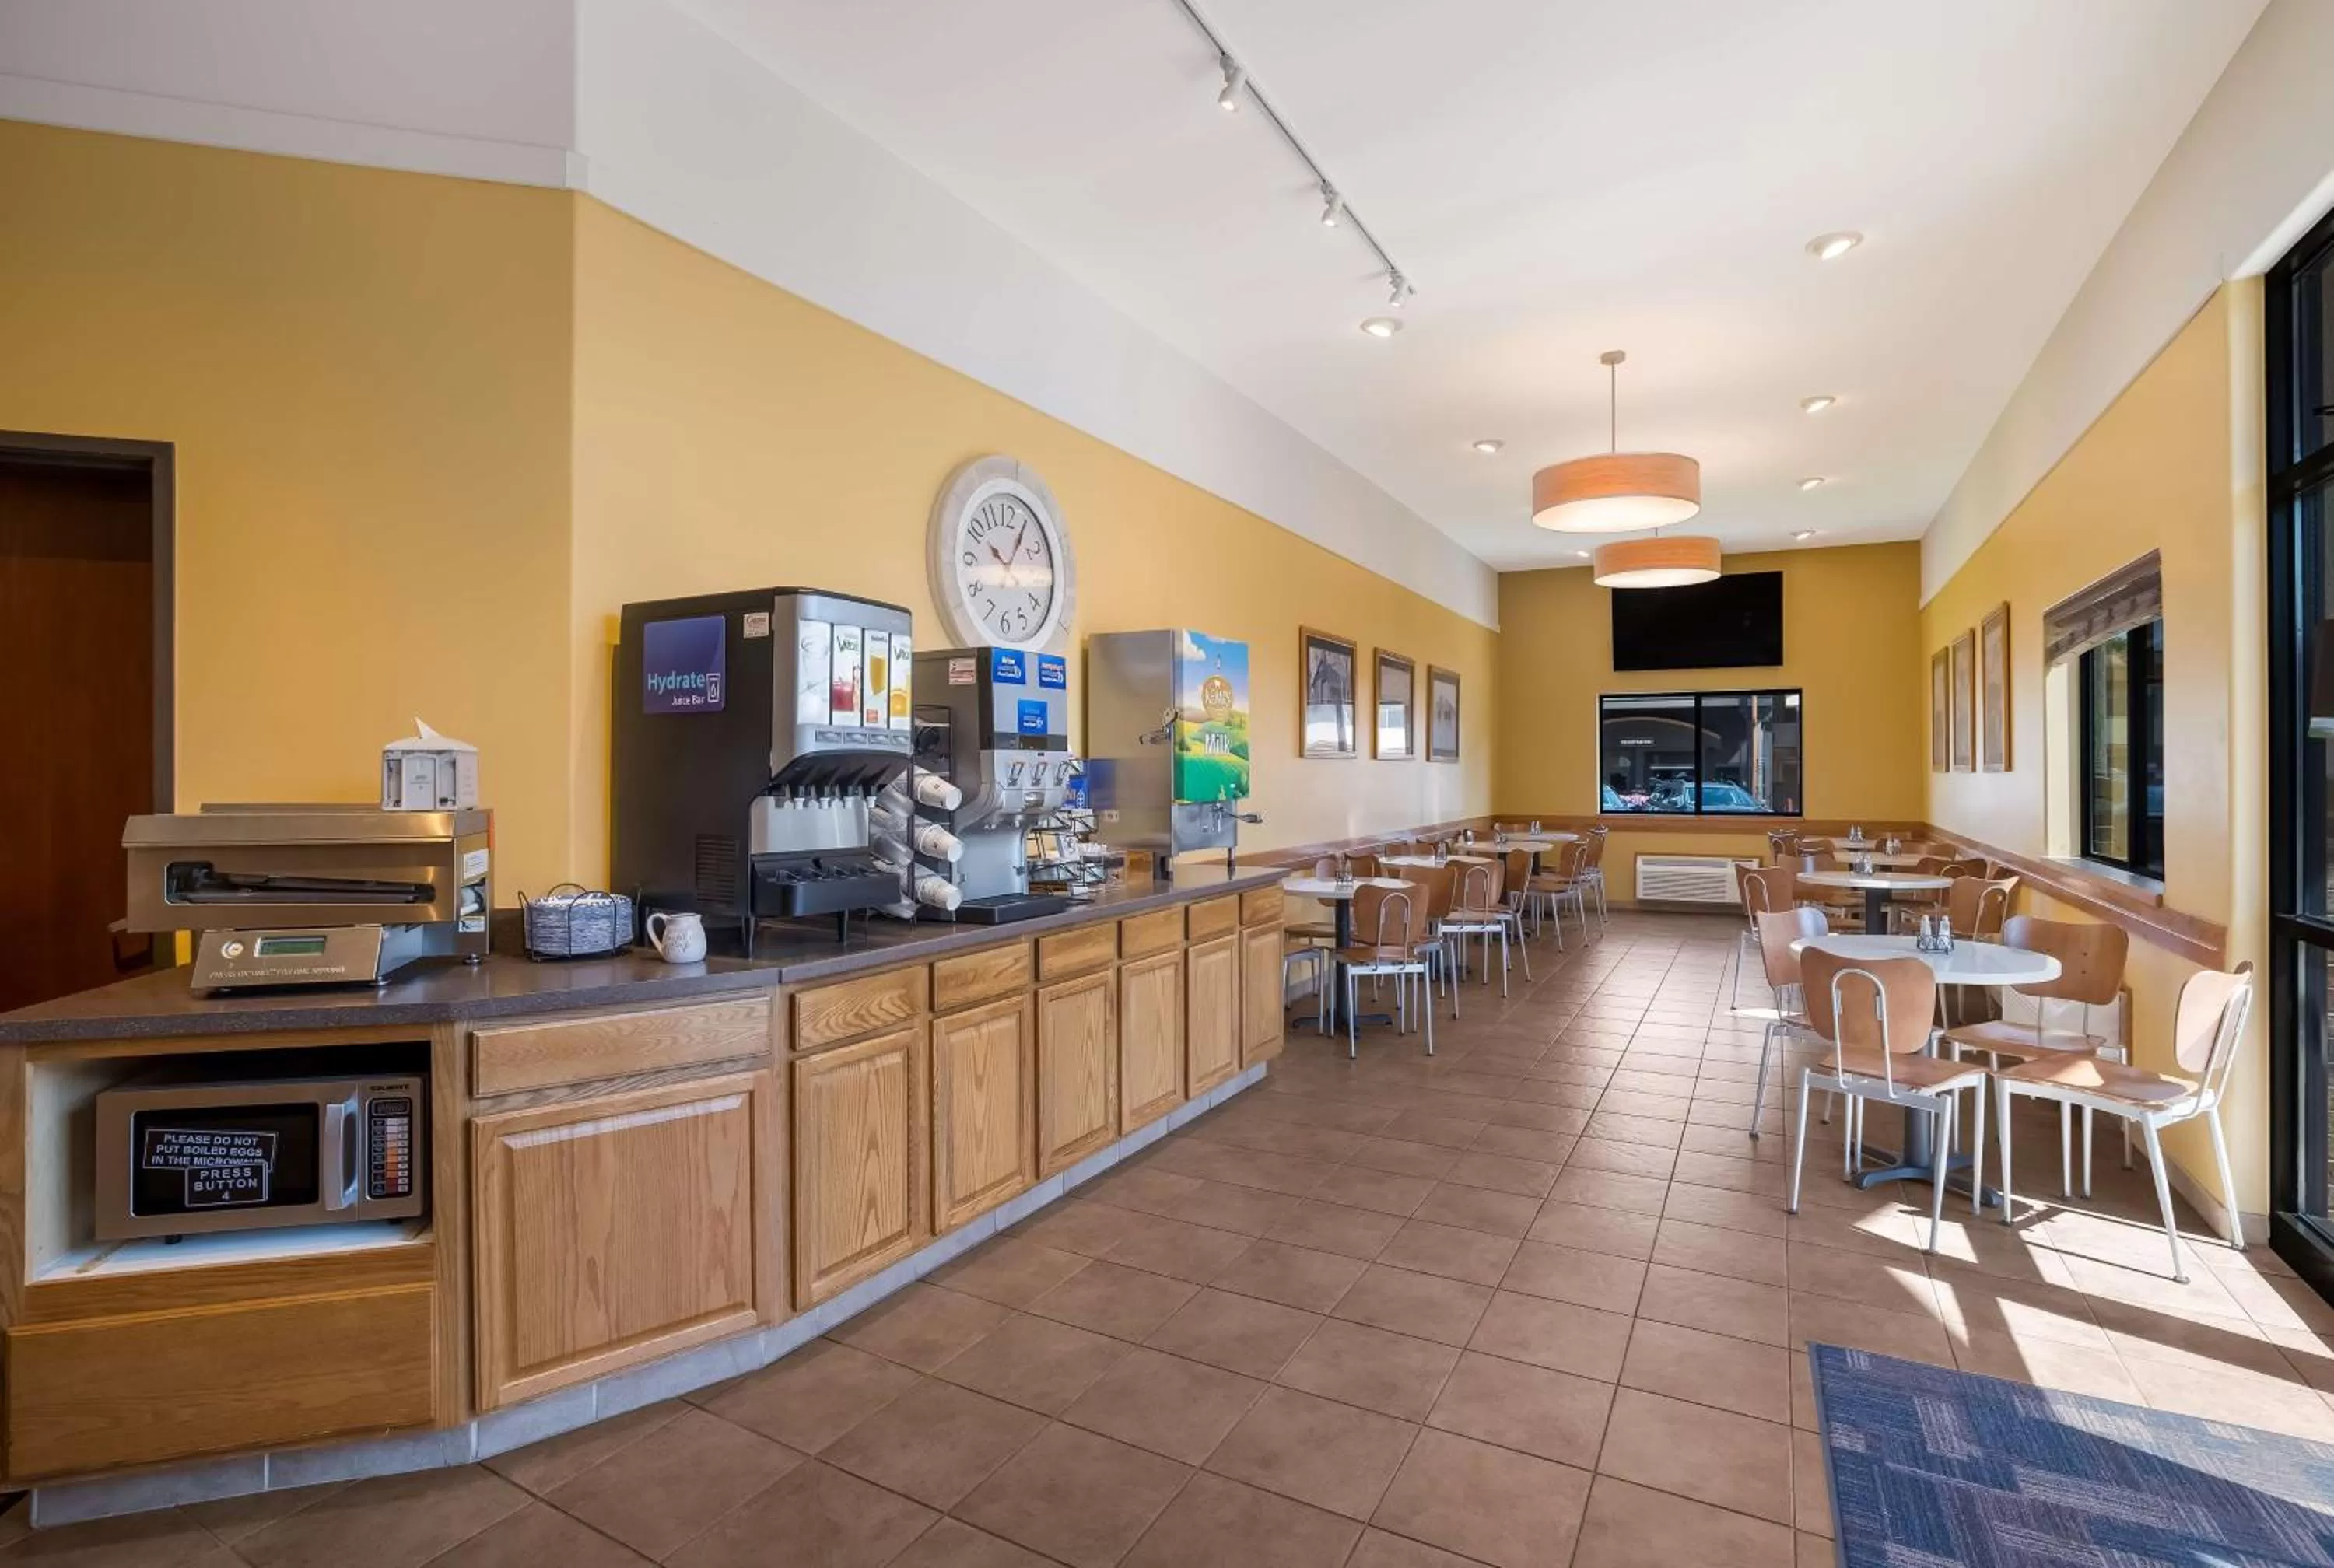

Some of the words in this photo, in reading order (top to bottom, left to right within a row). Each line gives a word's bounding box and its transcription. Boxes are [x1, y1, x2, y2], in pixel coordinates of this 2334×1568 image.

[982, 504, 997, 530] 11
[1000, 503, 1015, 529] 12
[967, 518, 985, 544] 10
[962, 551, 978, 567] 9
[1025, 541, 1040, 561] 2
[968, 579, 983, 597] 8
[983, 598, 996, 621] 7
[1028, 592, 1041, 611] 4
[1000, 611, 1011, 634] 6
[1017, 607, 1027, 630] 5
[647, 670, 706, 695] Hydrate
[671, 695, 691, 706] Juice
[692, 695, 705, 705] Bar
[1205, 733, 1230, 754] Milk
[164, 1134, 210, 1144] PLEASE
[214, 1136, 231, 1146] DO
[234, 1136, 258, 1146] NOT
[156, 1144, 180, 1154] PUT
[183, 1145, 226, 1156] BOILED
[230, 1147, 263, 1157] EGGS
[152, 1156, 166, 1165] IN
[169, 1156, 191, 1165] THE
[200, 1167, 251, 1180] PRESS
[194, 1178, 258, 1191] BUTTON
[222, 1190, 230, 1200] 4
